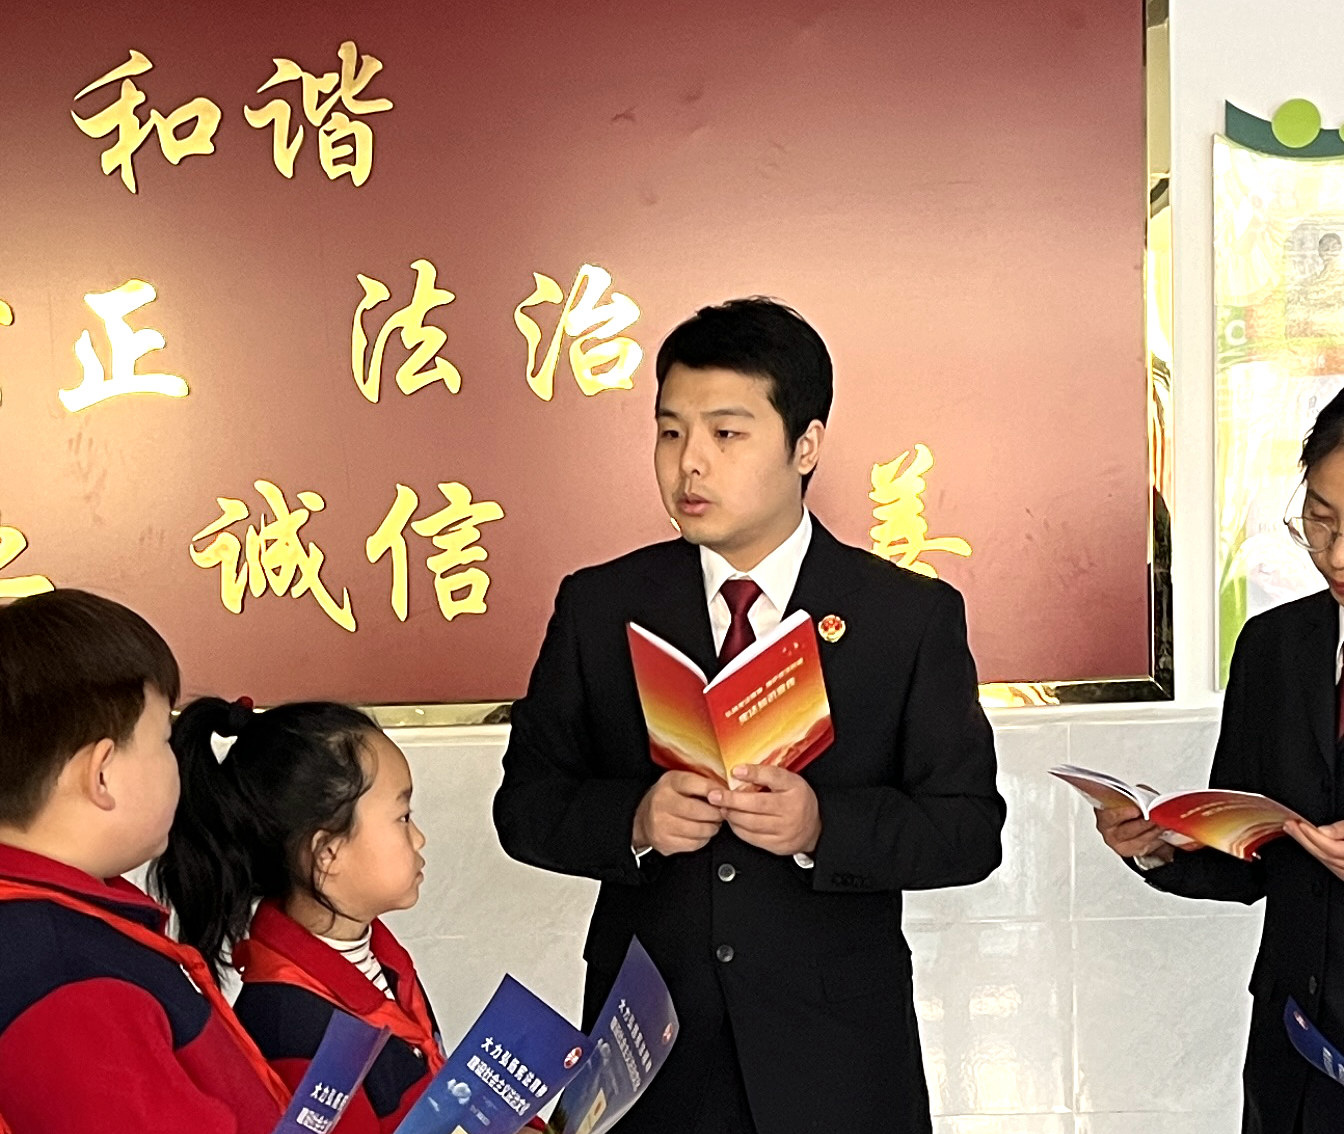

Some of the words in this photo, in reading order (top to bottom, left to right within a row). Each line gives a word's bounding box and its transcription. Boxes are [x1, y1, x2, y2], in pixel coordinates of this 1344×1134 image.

[71, 41, 394, 194] 和谐
[351, 258, 645, 404] 法治
[189, 480, 505, 633] 诚信
